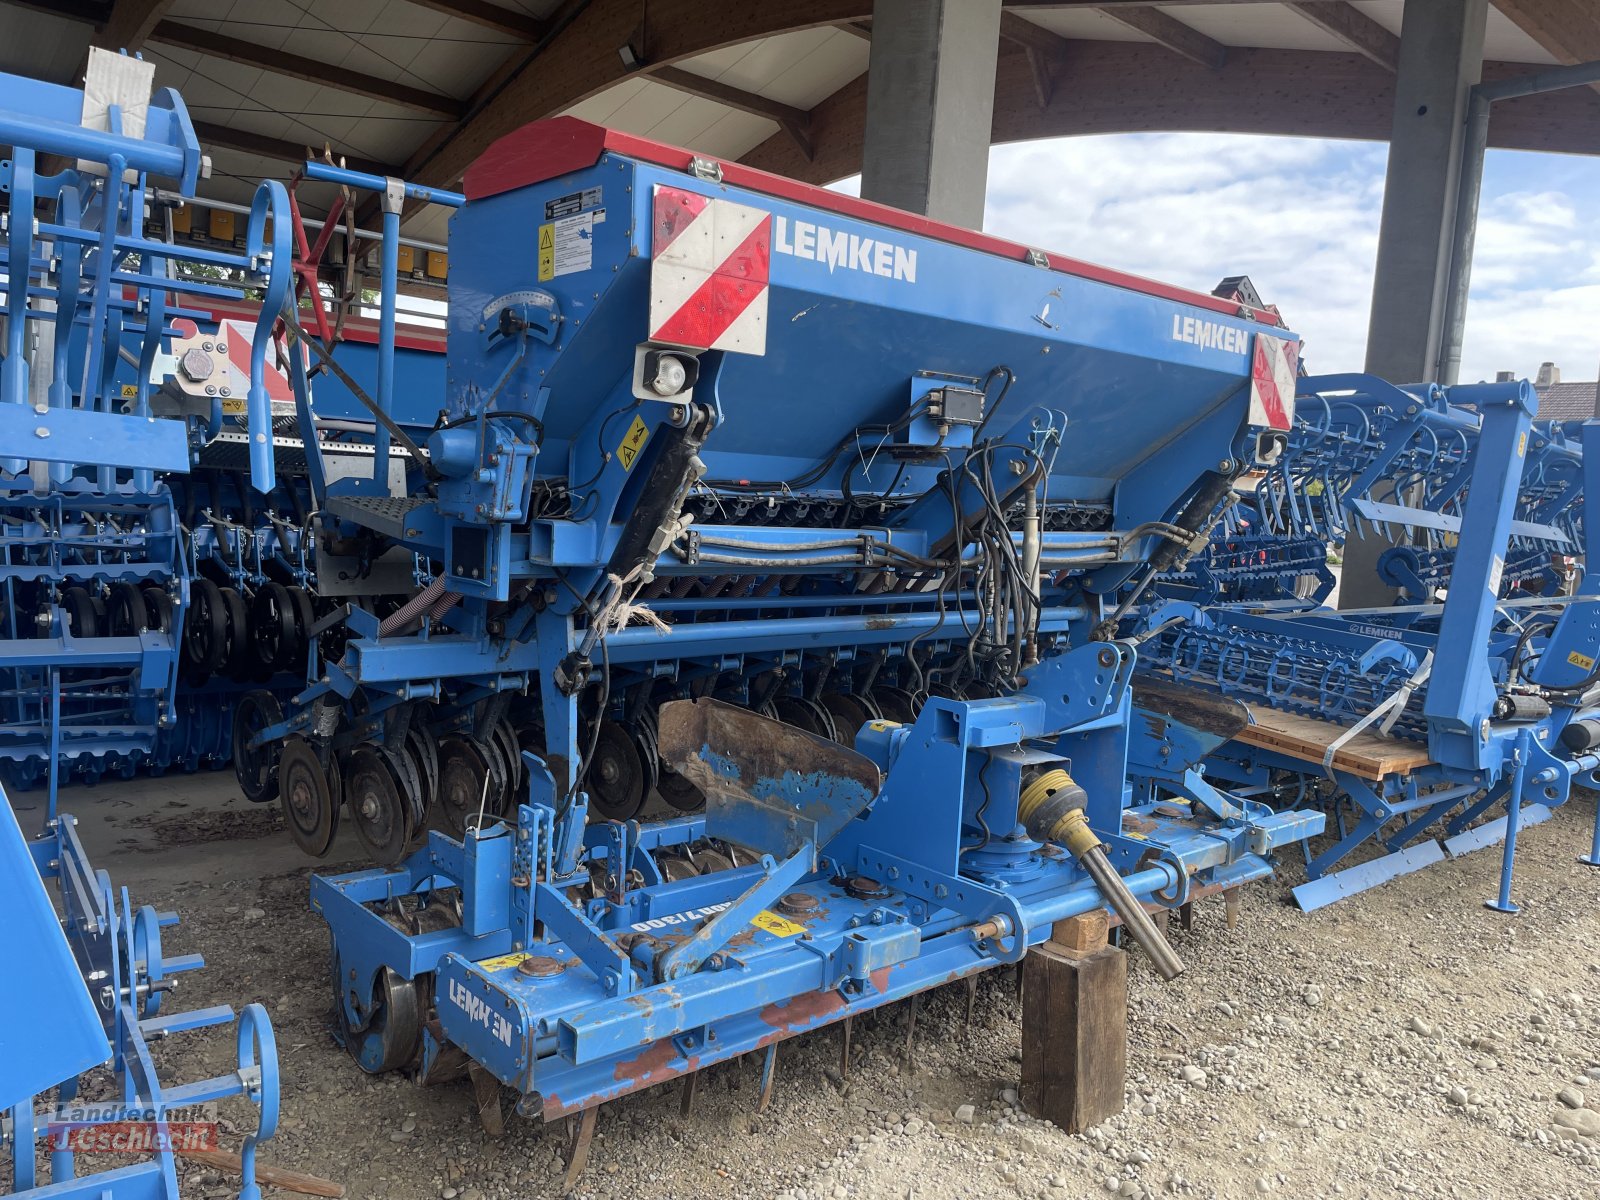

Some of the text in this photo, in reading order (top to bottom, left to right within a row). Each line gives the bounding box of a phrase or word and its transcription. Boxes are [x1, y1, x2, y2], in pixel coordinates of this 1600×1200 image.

[775, 215, 917, 284] LEMKEN
[1173, 314, 1248, 355] LEMKEN
[1360, 626, 1402, 639] LEMKEN
[630, 907, 703, 932] 7/300
